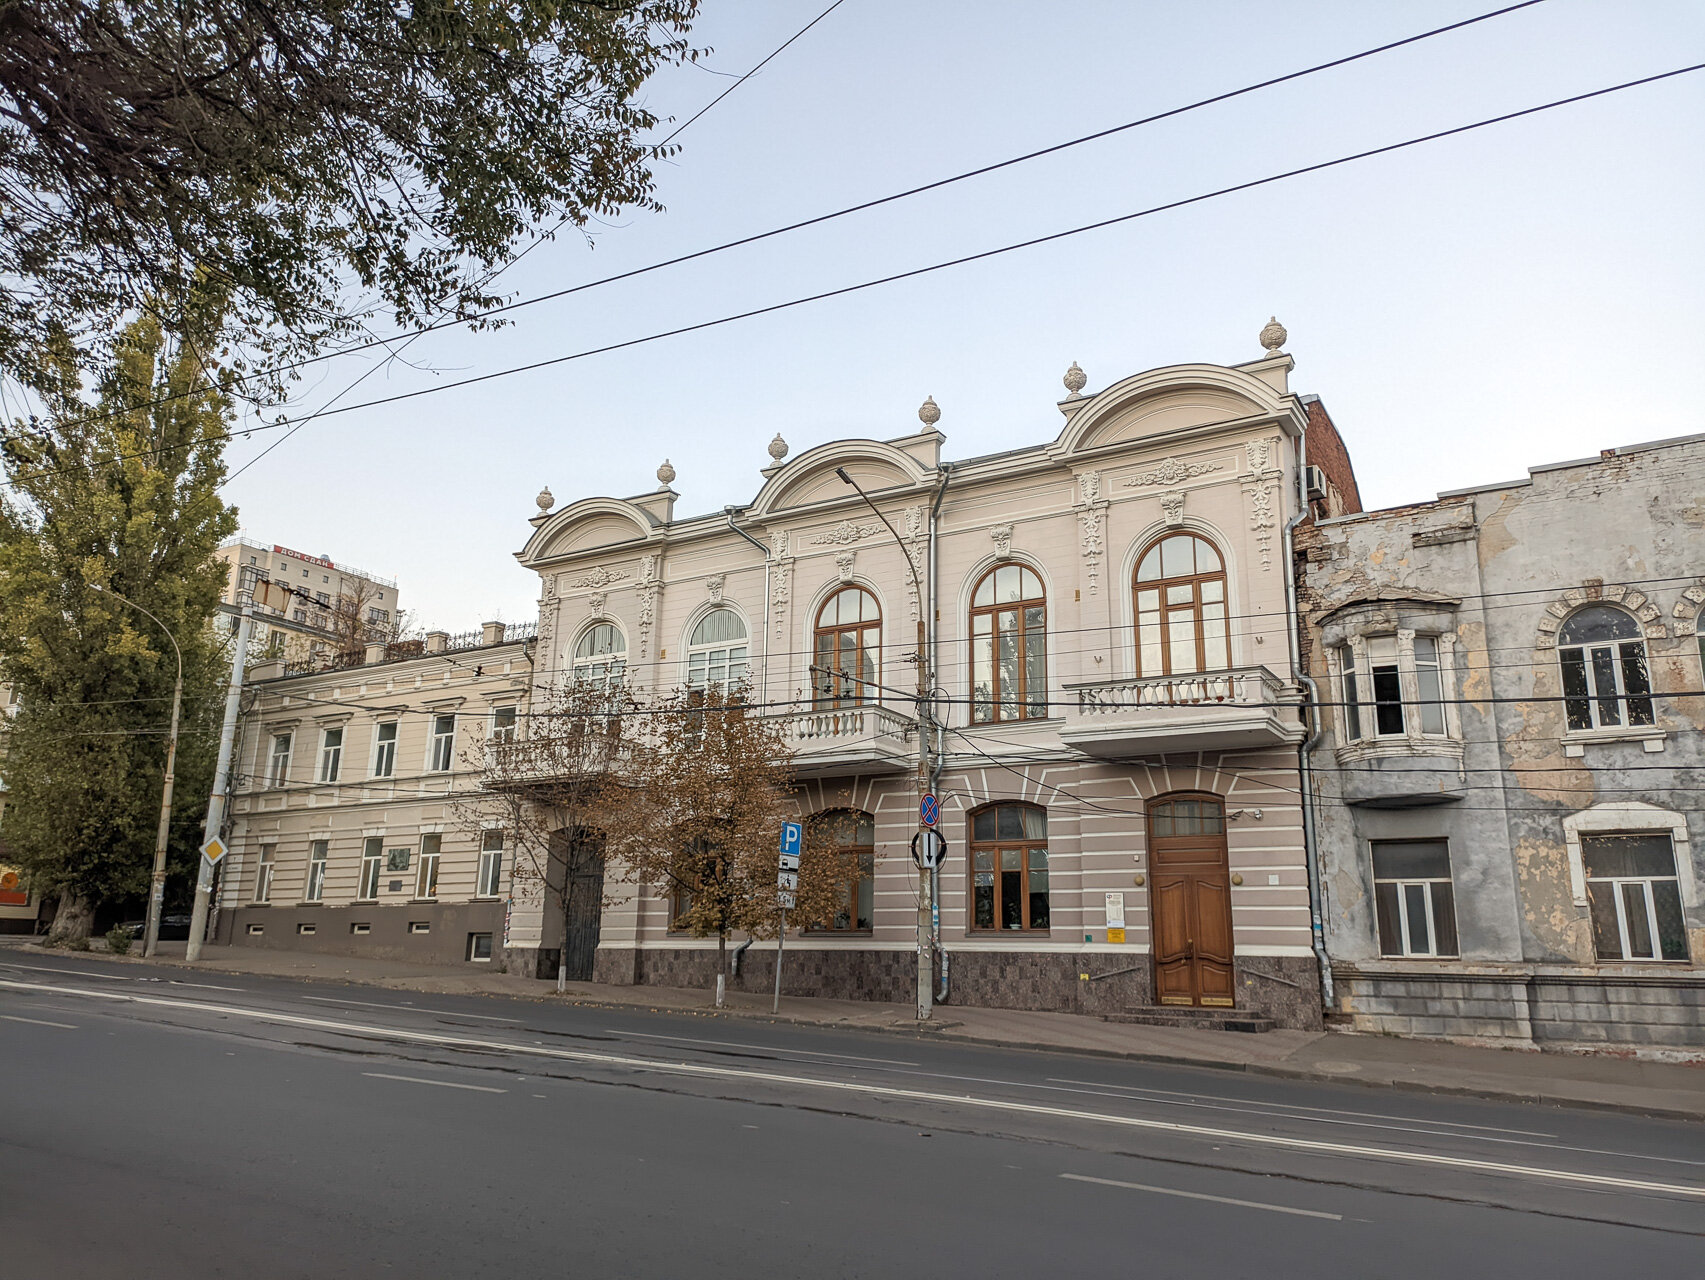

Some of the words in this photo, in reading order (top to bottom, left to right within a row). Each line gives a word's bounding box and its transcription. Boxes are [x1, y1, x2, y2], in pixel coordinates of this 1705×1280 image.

[281, 548, 301, 558] ДОМ
[304, 555, 328, 567] СДАН
[785, 826, 798, 850] P
